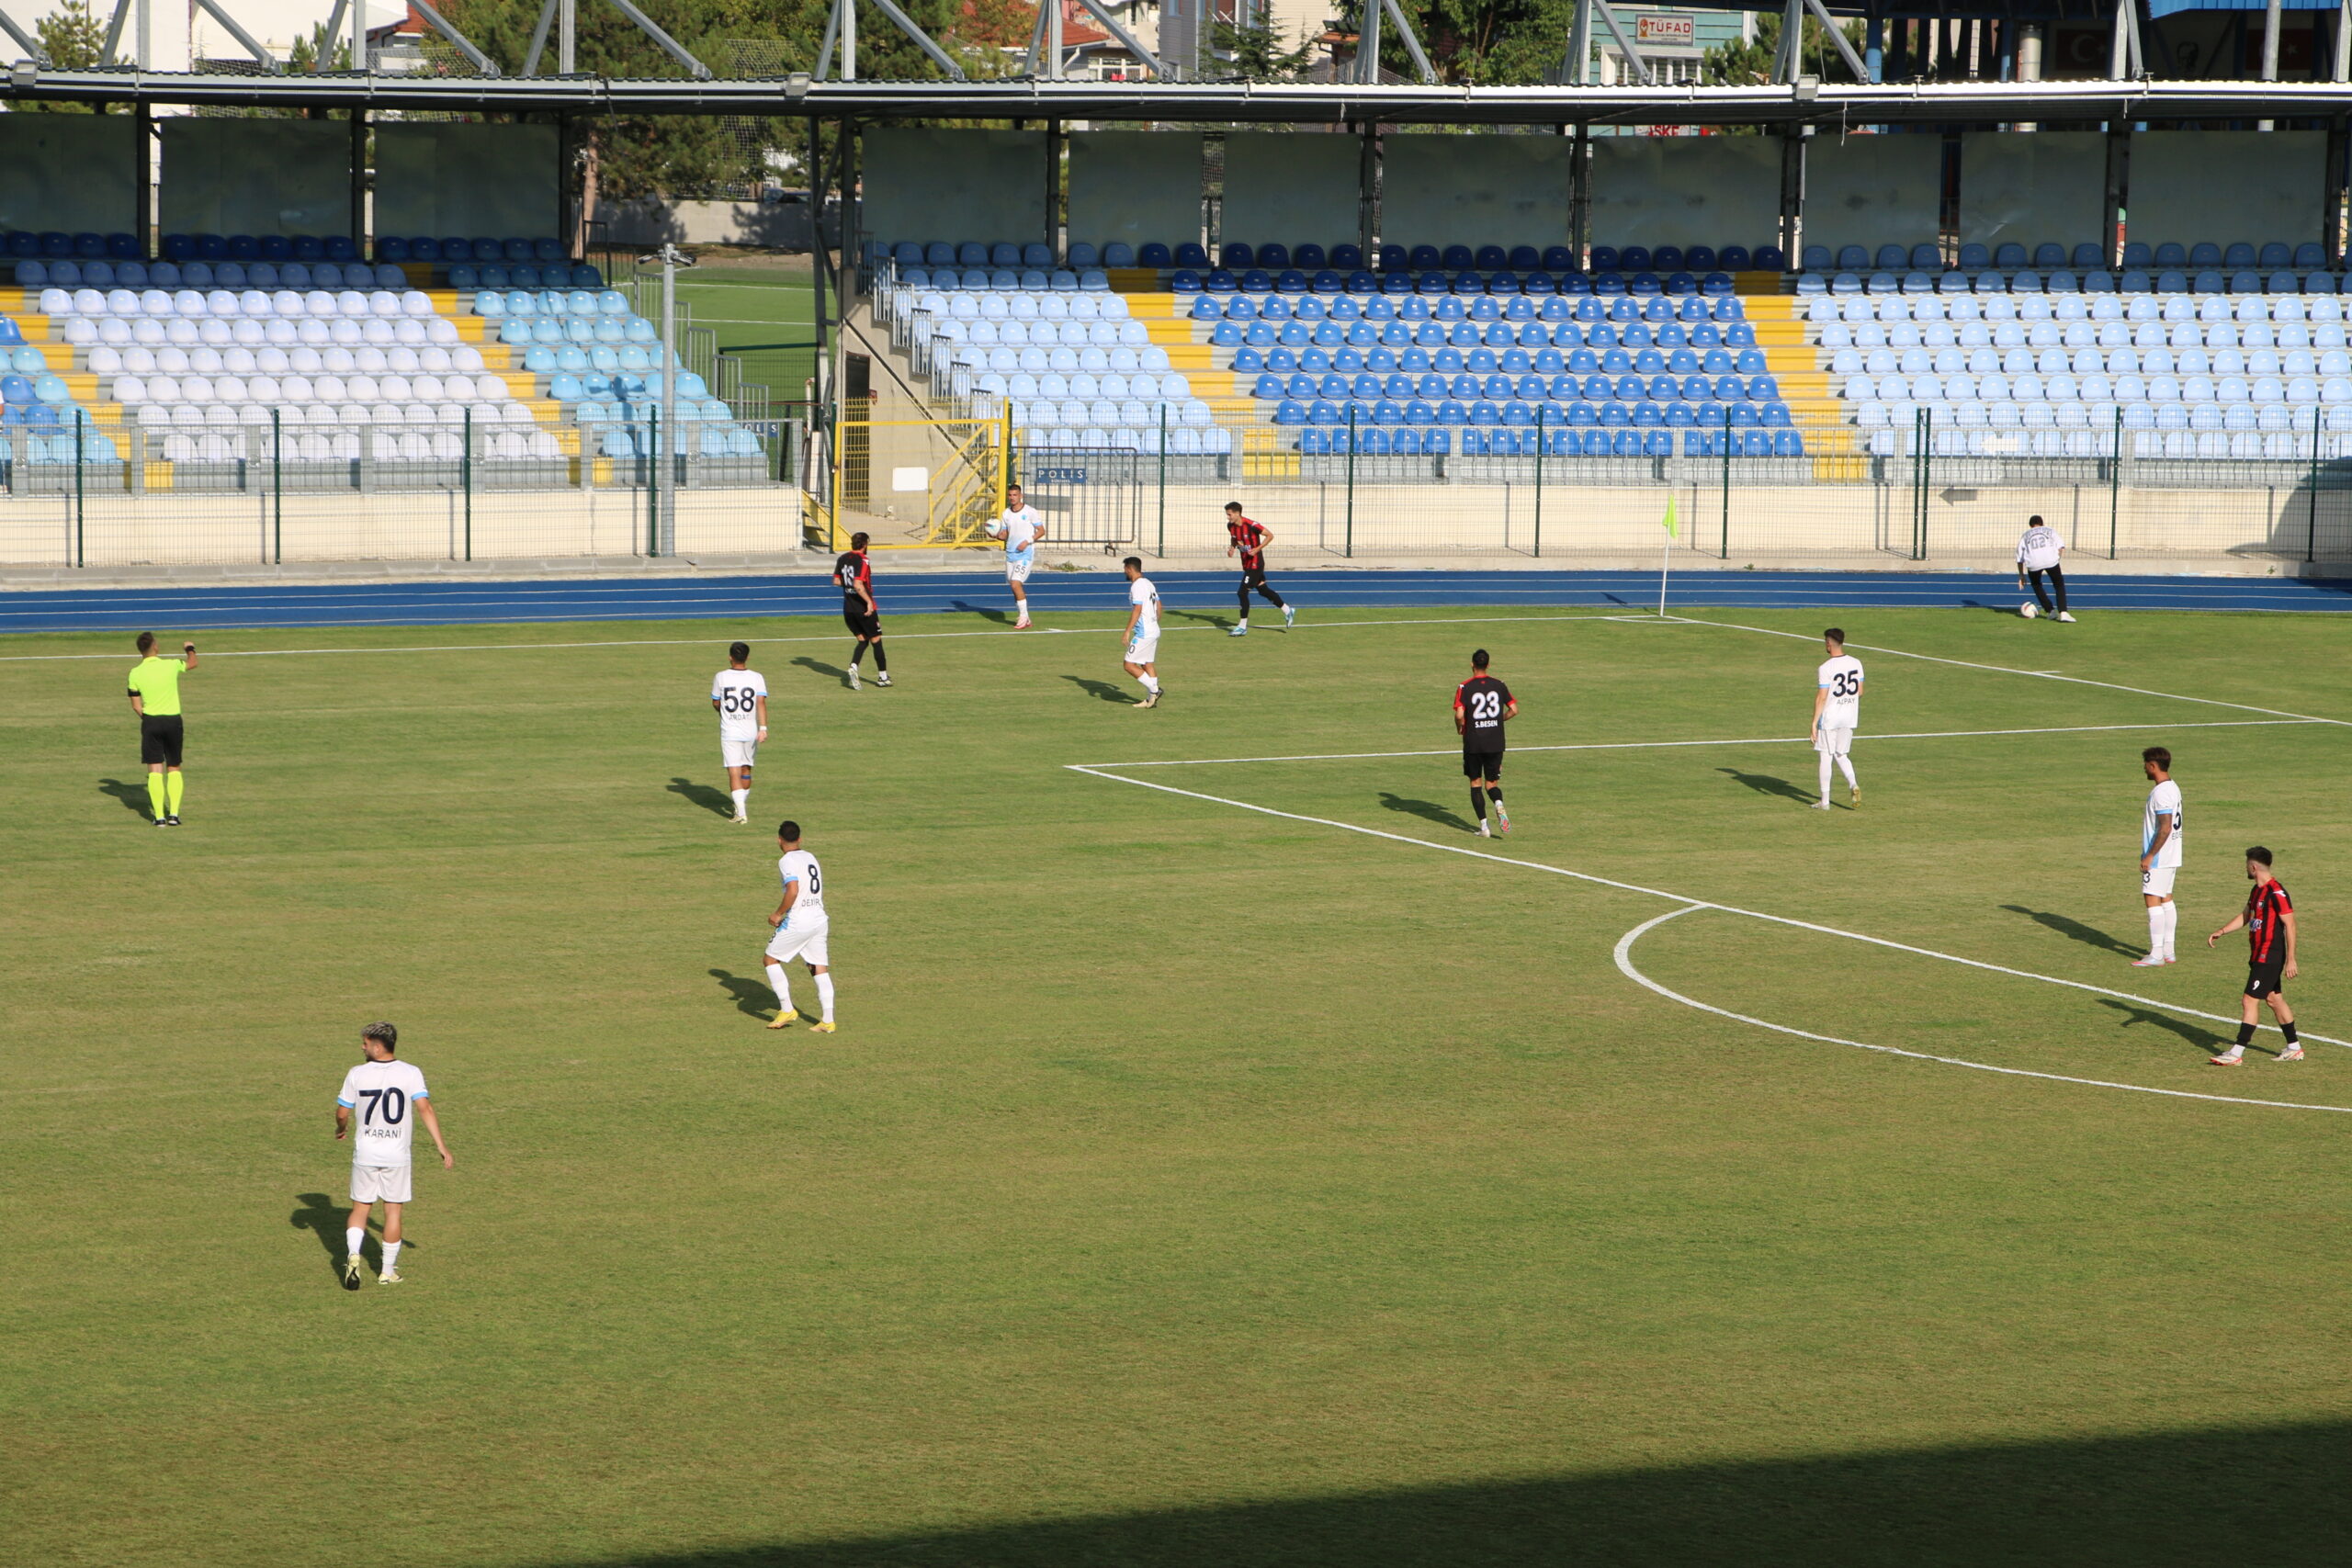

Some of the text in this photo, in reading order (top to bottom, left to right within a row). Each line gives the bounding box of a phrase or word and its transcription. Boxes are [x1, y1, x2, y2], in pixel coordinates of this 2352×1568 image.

[1649, 18, 1690, 33] TÜFAD
[1014, 565, 1026, 575] 55
[1832, 669, 1859, 697] 35
[723, 686, 755, 713] 58
[1471, 690, 1500, 719] 23
[1475, 720, 1498, 728] S.BESEN
[808, 863, 820, 895] 8
[2252, 979, 2260, 991] 9
[358, 1087, 405, 1126] 70
